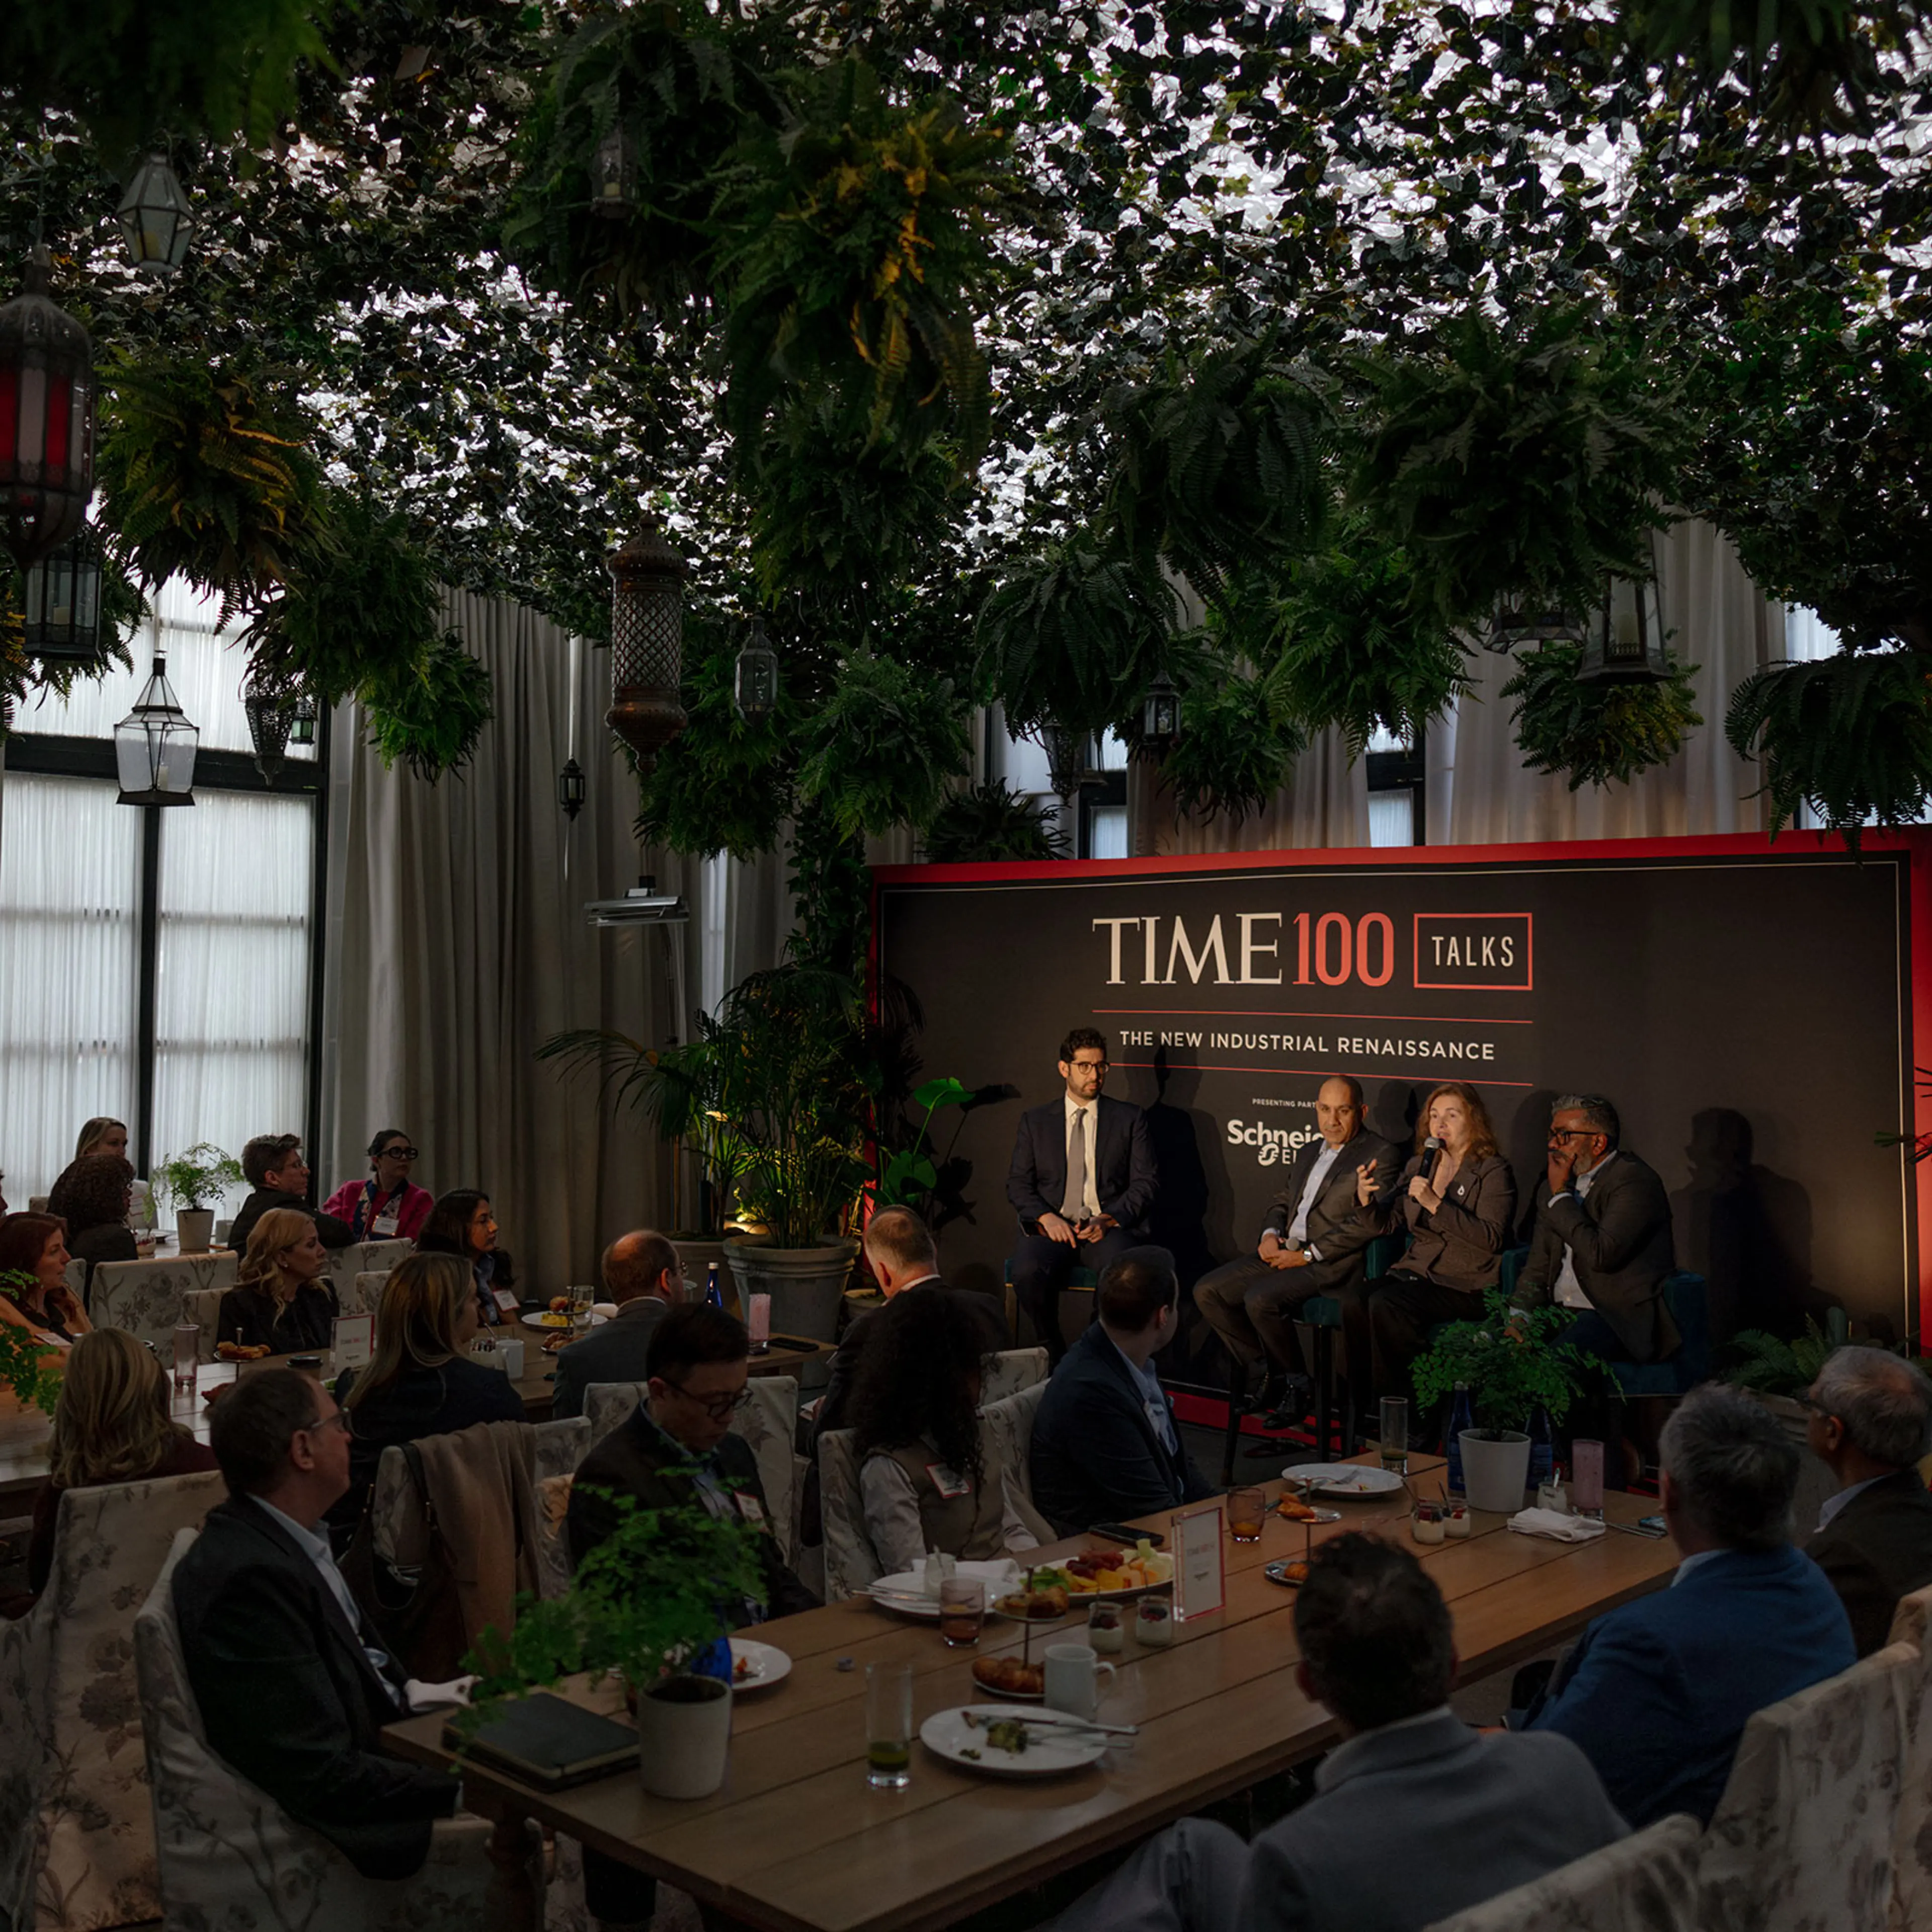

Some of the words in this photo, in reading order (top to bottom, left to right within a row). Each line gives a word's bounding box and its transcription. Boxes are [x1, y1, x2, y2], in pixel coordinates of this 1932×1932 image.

[1431, 936, 1514, 967] TALKS
[1119, 1030, 1153, 1046] THE
[1161, 1031, 1203, 1048] NEW
[1211, 1033, 1329, 1053] INDUSTRIAL
[1338, 1037, 1495, 1061] RENAISSANCE
[1252, 1098, 1296, 1107] PRESENTING
